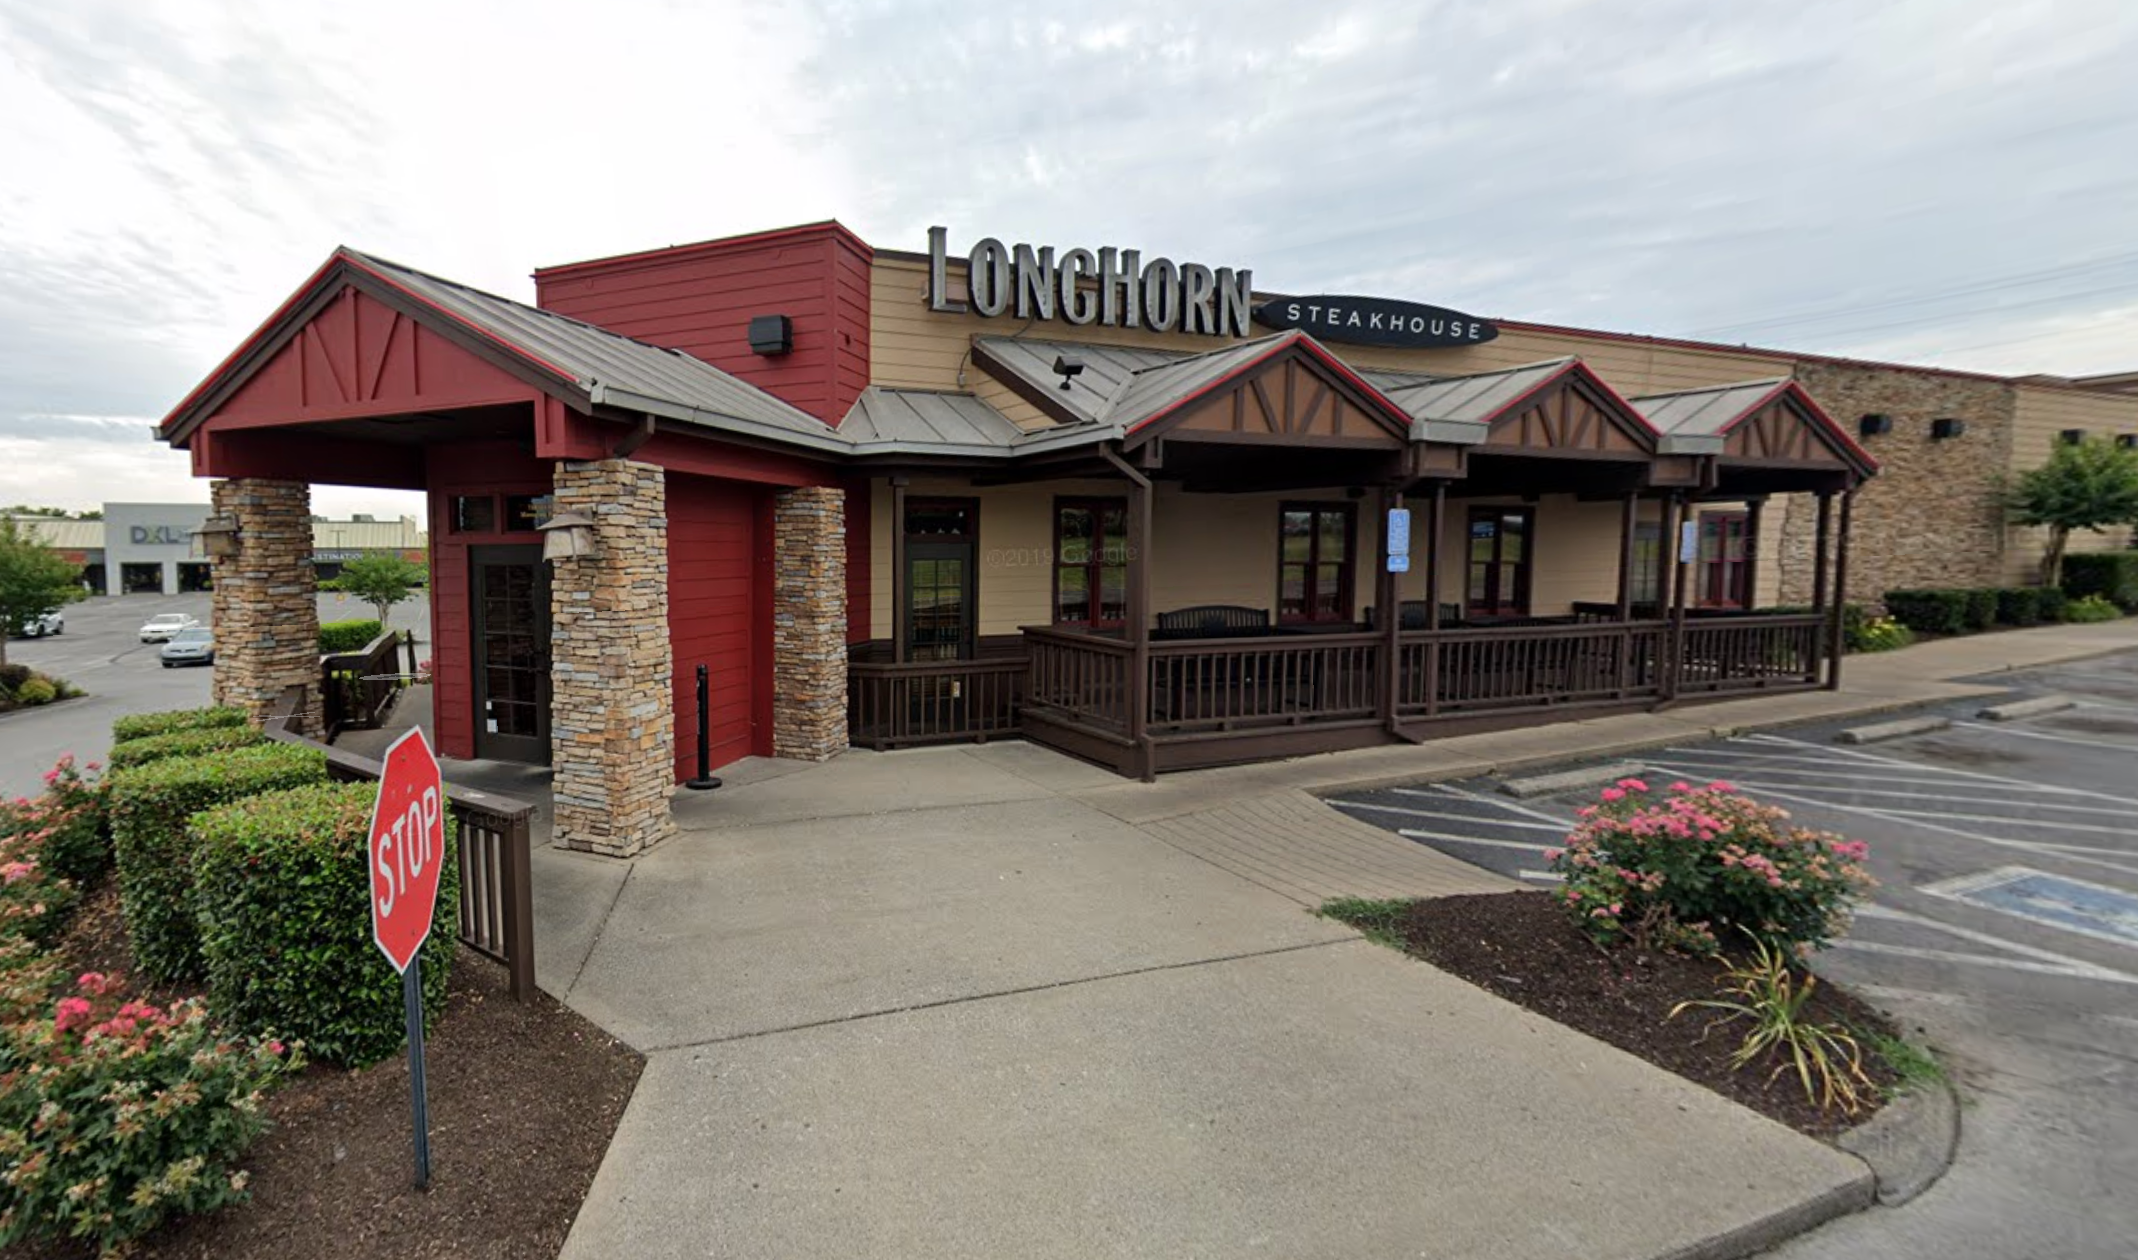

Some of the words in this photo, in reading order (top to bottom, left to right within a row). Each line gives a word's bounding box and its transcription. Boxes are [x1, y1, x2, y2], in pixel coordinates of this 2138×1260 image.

[928, 226, 1252, 337] LONGHORN
[1286, 303, 1481, 339] STEAKHOUSE
[131, 526, 178, 544] DXL
[378, 785, 437, 918] STOP
